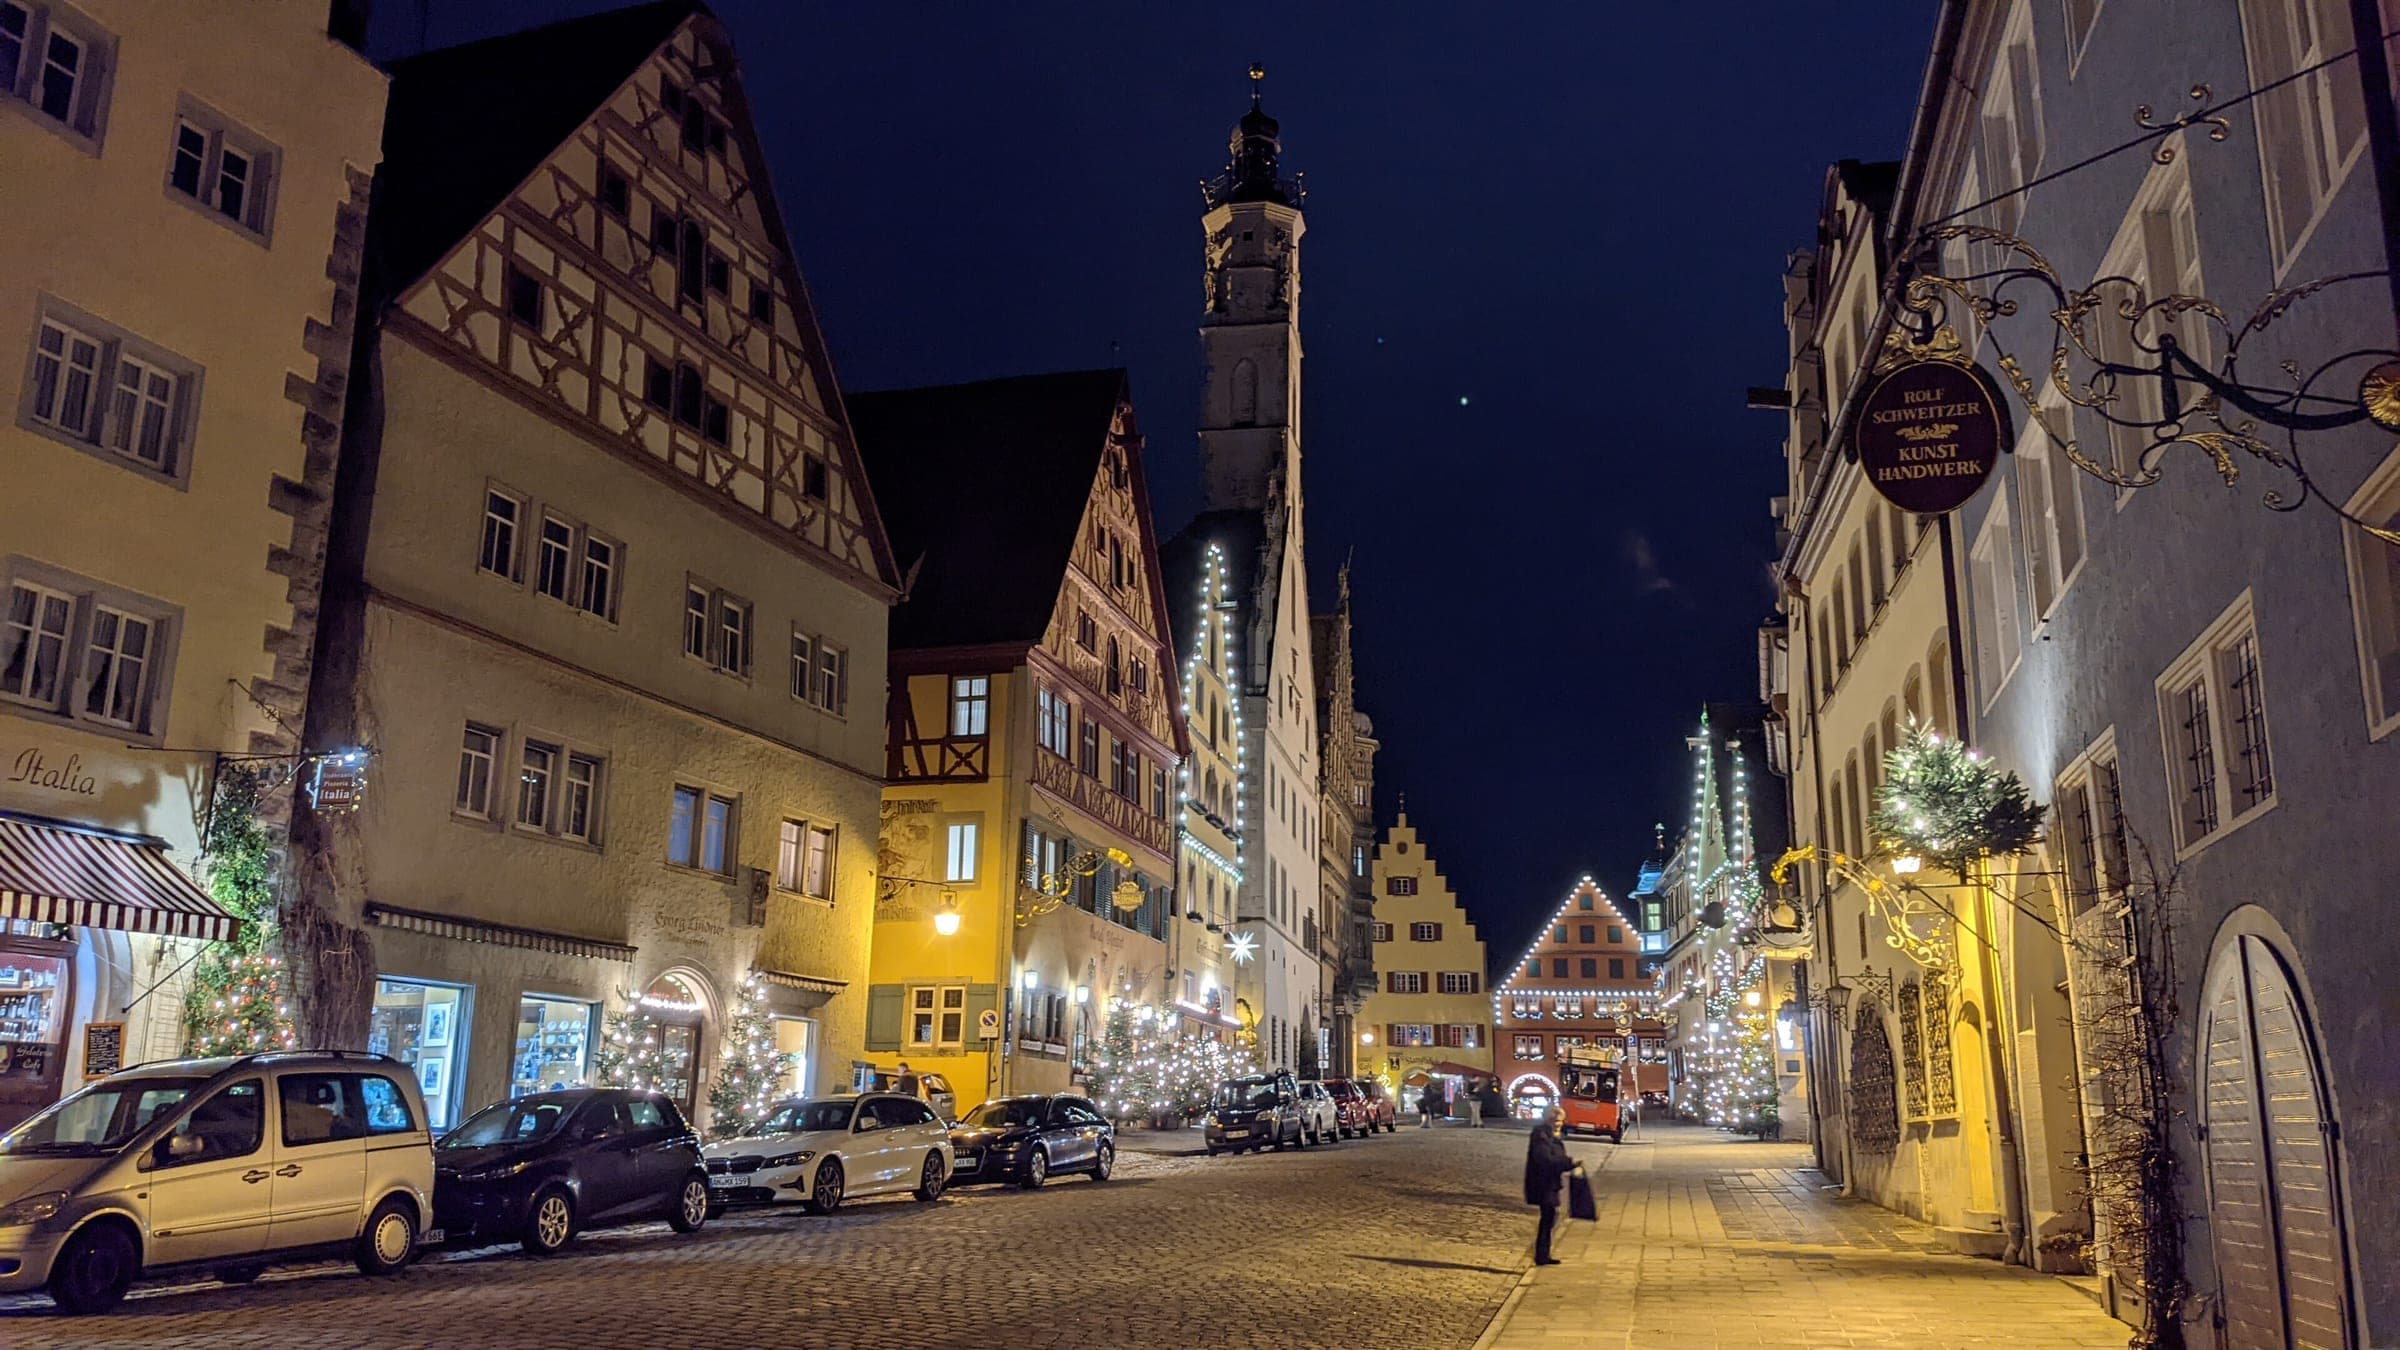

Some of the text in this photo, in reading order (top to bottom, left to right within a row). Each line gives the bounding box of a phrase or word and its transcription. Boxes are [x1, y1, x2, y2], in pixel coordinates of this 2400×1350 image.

[1904, 389, 1945, 404] ROLF
[1872, 402, 1981, 424] SCHWEITZER
[1899, 443, 1959, 461] KUNST
[1878, 460, 1983, 481] HANDWERK
[8, 747, 95, 795] Italia
[320, 789, 350, 800] Italia
